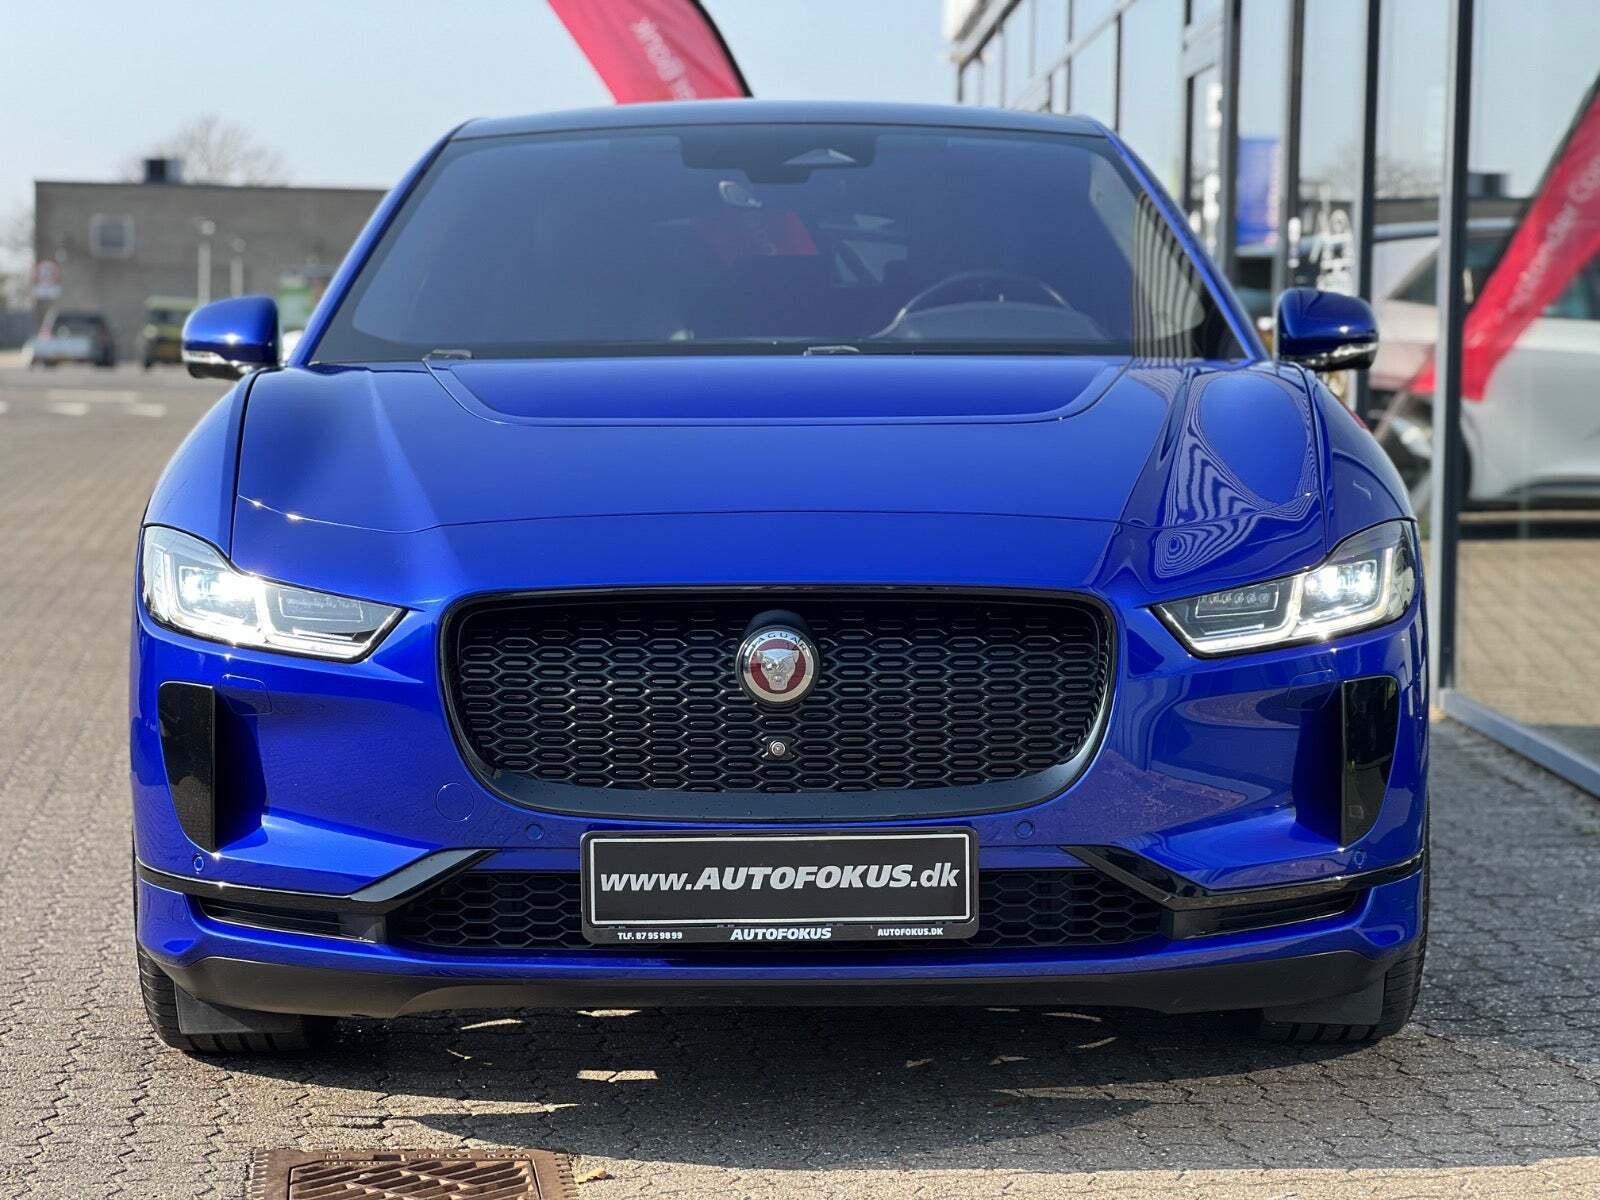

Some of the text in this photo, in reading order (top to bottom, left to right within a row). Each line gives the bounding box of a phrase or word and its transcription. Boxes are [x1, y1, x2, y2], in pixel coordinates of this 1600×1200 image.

[751, 631, 807, 651] JAGUAR
[600, 862, 960, 892] www.AUTOFOKUS.dk
[617, 932, 635, 940] TLF.
[647, 932, 659, 940] 95
[730, 928, 832, 941] AUTOFOKUS
[877, 927, 944, 937] AUTOFOKUS.DK
